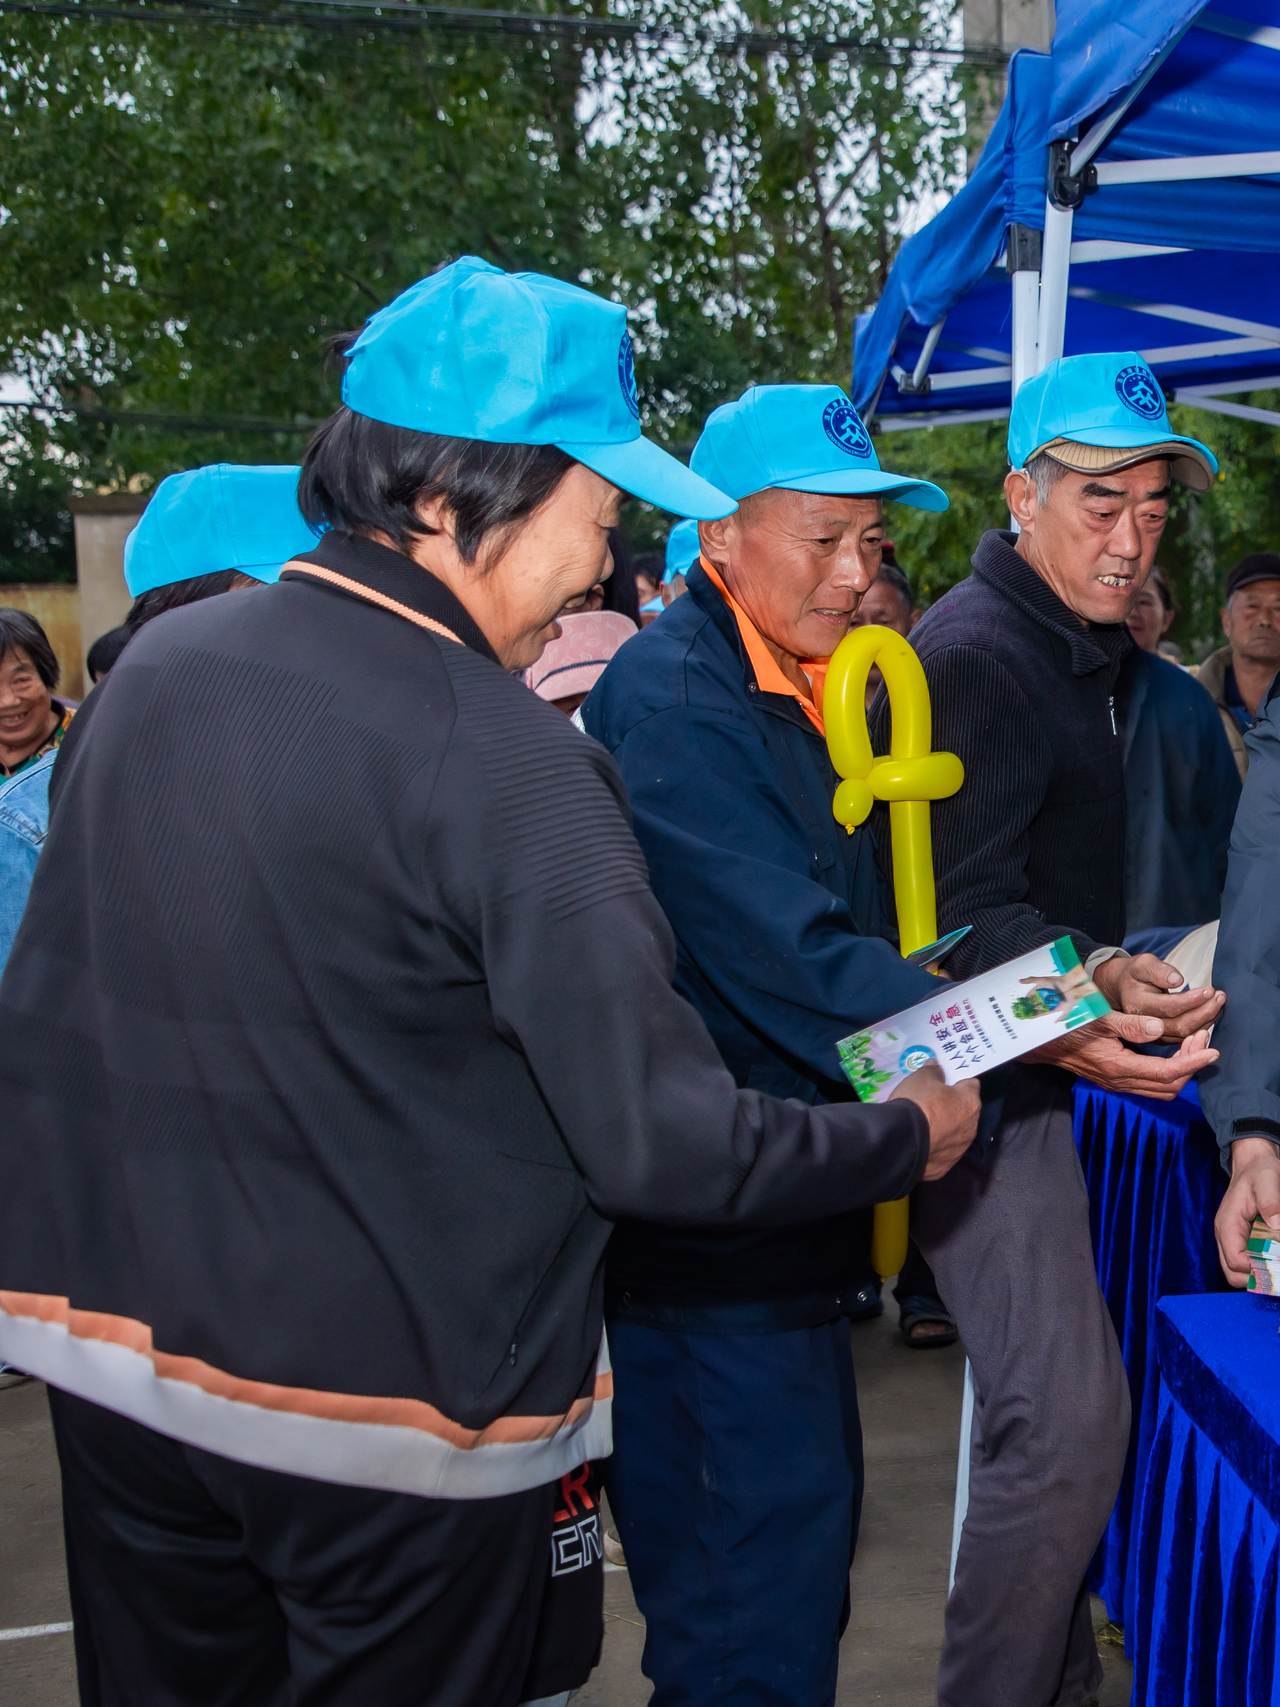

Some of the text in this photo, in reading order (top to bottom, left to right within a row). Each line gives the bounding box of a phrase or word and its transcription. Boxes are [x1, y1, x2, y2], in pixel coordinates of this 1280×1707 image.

[929, 1011, 970, 1071] 人人讲安全
[945, 1003, 985, 1064] 个个会应急
